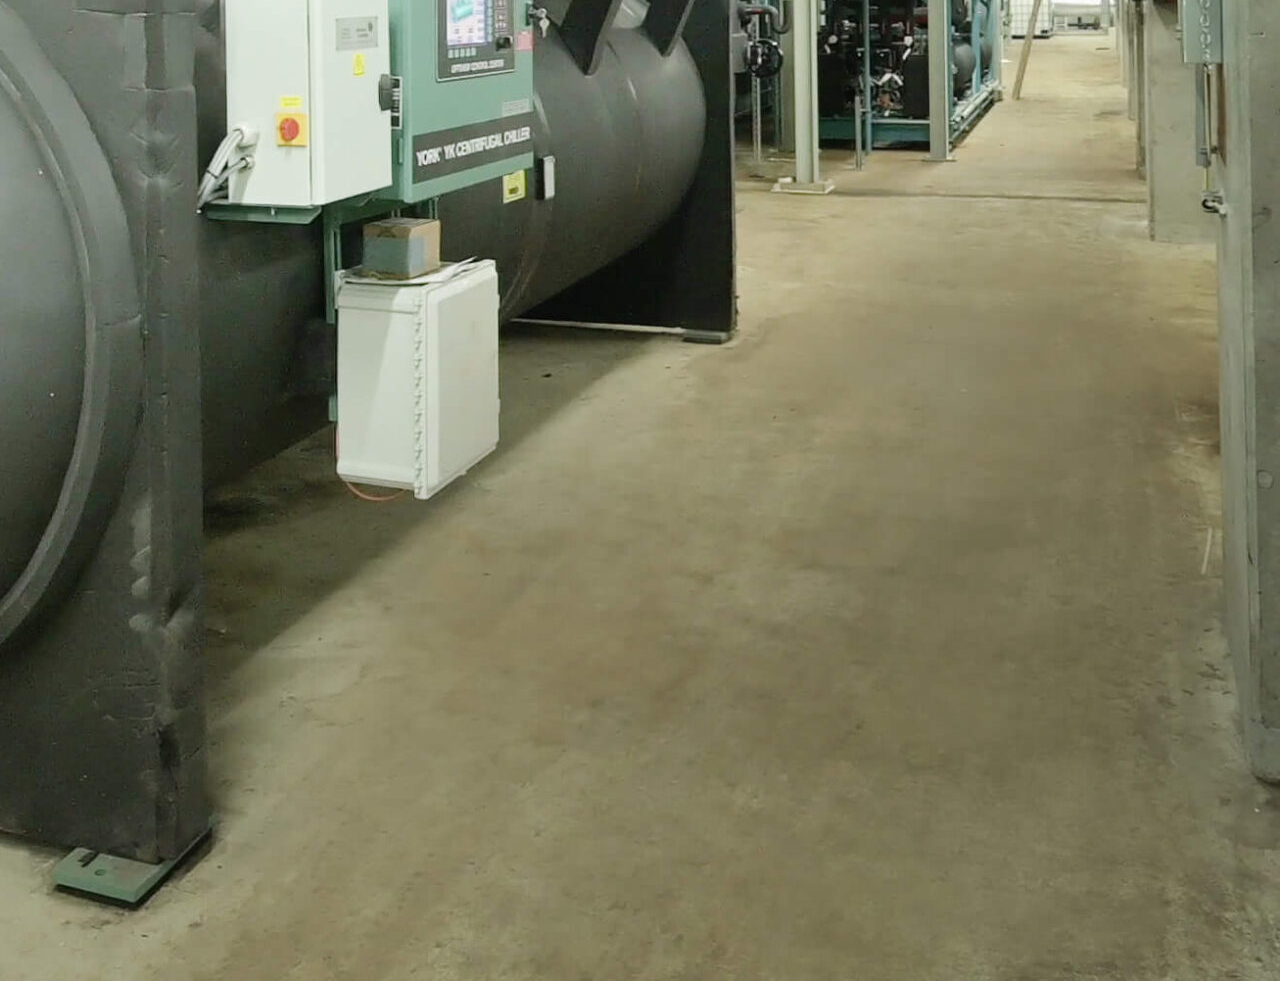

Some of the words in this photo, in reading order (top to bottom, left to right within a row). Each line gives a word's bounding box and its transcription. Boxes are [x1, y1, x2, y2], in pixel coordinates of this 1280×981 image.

[443, 143, 456, 160] YK
[456, 133, 503, 157] CENTRIFUGAL
[503, 126, 531, 145] CHILLER
